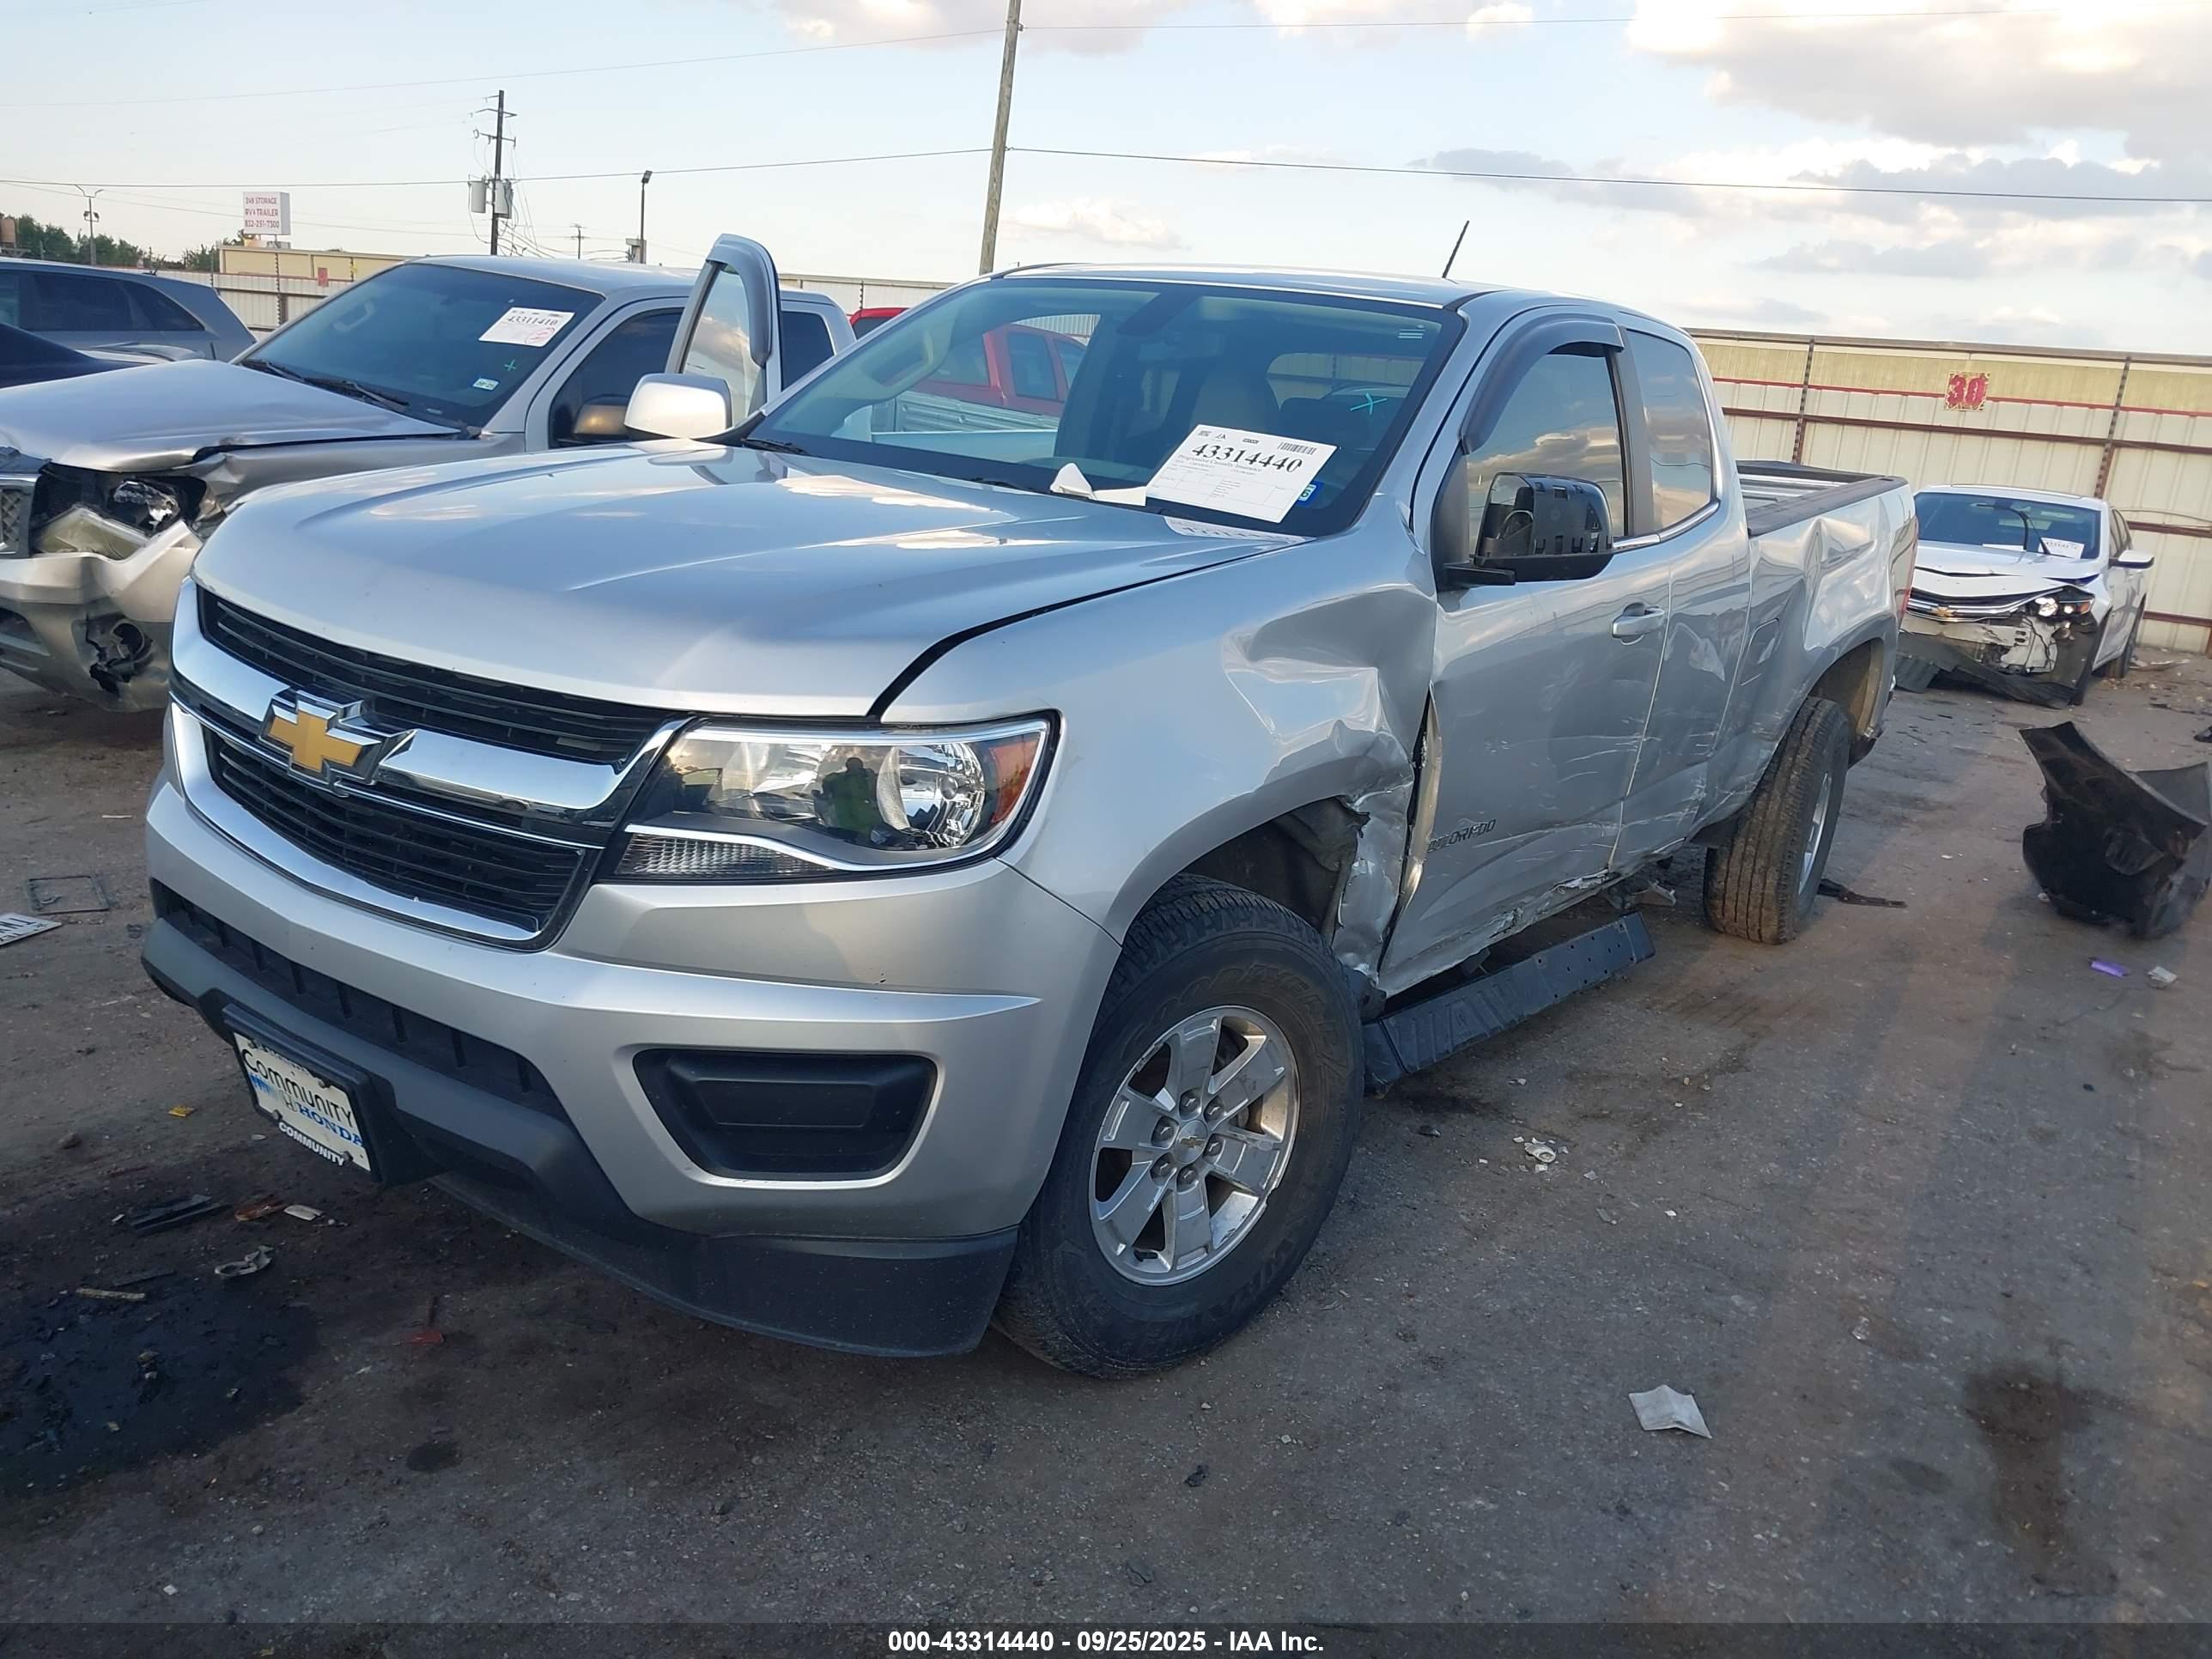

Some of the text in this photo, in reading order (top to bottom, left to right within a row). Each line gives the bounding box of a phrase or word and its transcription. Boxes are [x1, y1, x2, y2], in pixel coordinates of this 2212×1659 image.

[1947, 375, 1986, 406] 30
[1192, 443, 1303, 472] 43314440
[296, 1103, 364, 1147] HONDA
[278, 1121, 345, 1167] COMMUNITY
